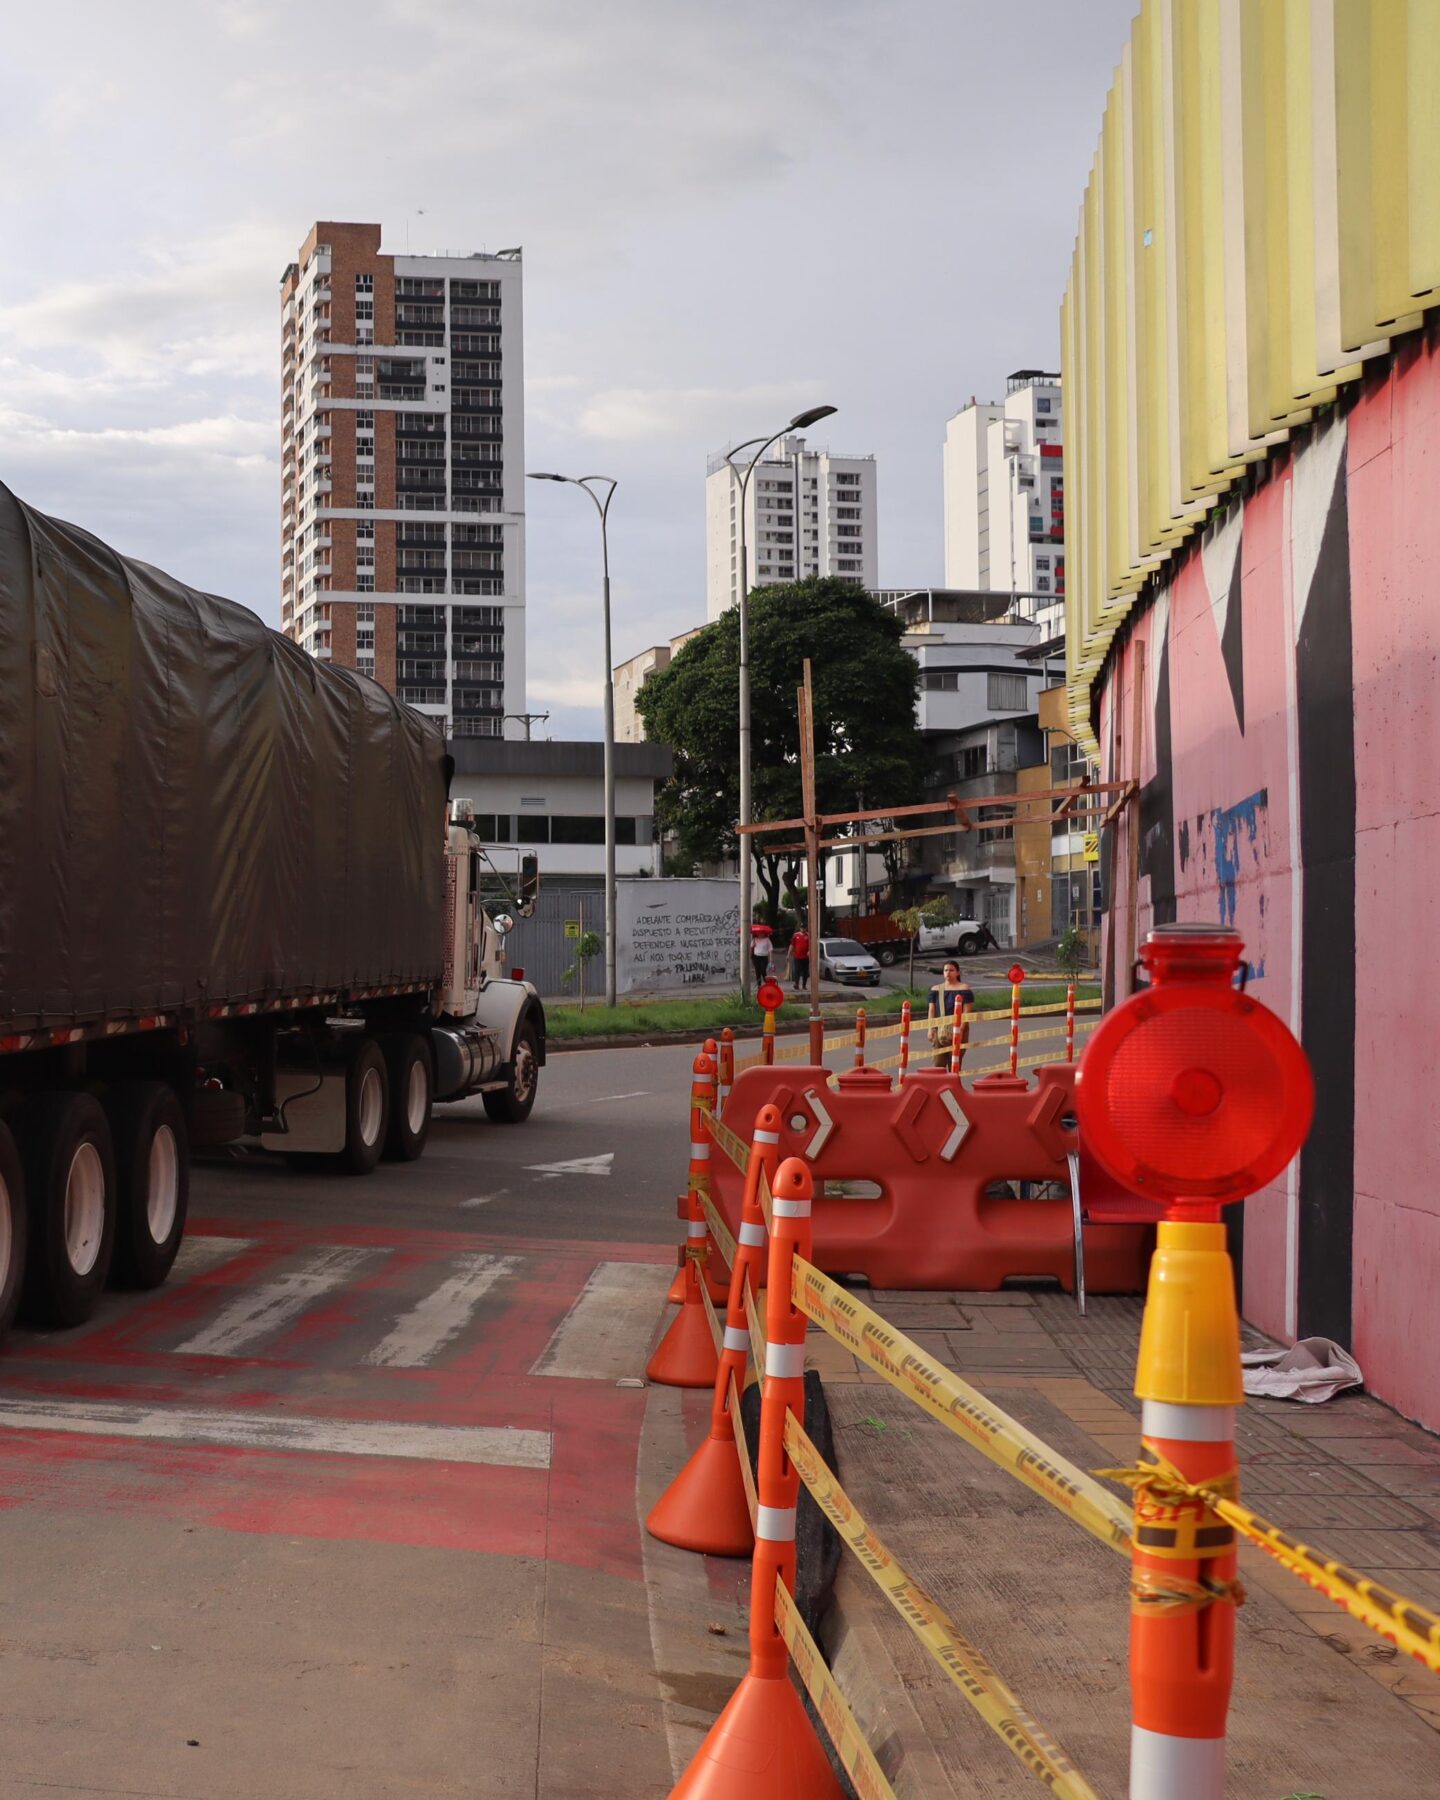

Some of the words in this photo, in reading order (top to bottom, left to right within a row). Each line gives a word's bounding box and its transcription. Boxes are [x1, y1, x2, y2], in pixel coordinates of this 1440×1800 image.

[637, 915, 671, 925] ADELANTE
[675, 927, 681, 937] A
[632, 940, 675, 950] DEFENDER
[650, 953, 665, 962] NOS
